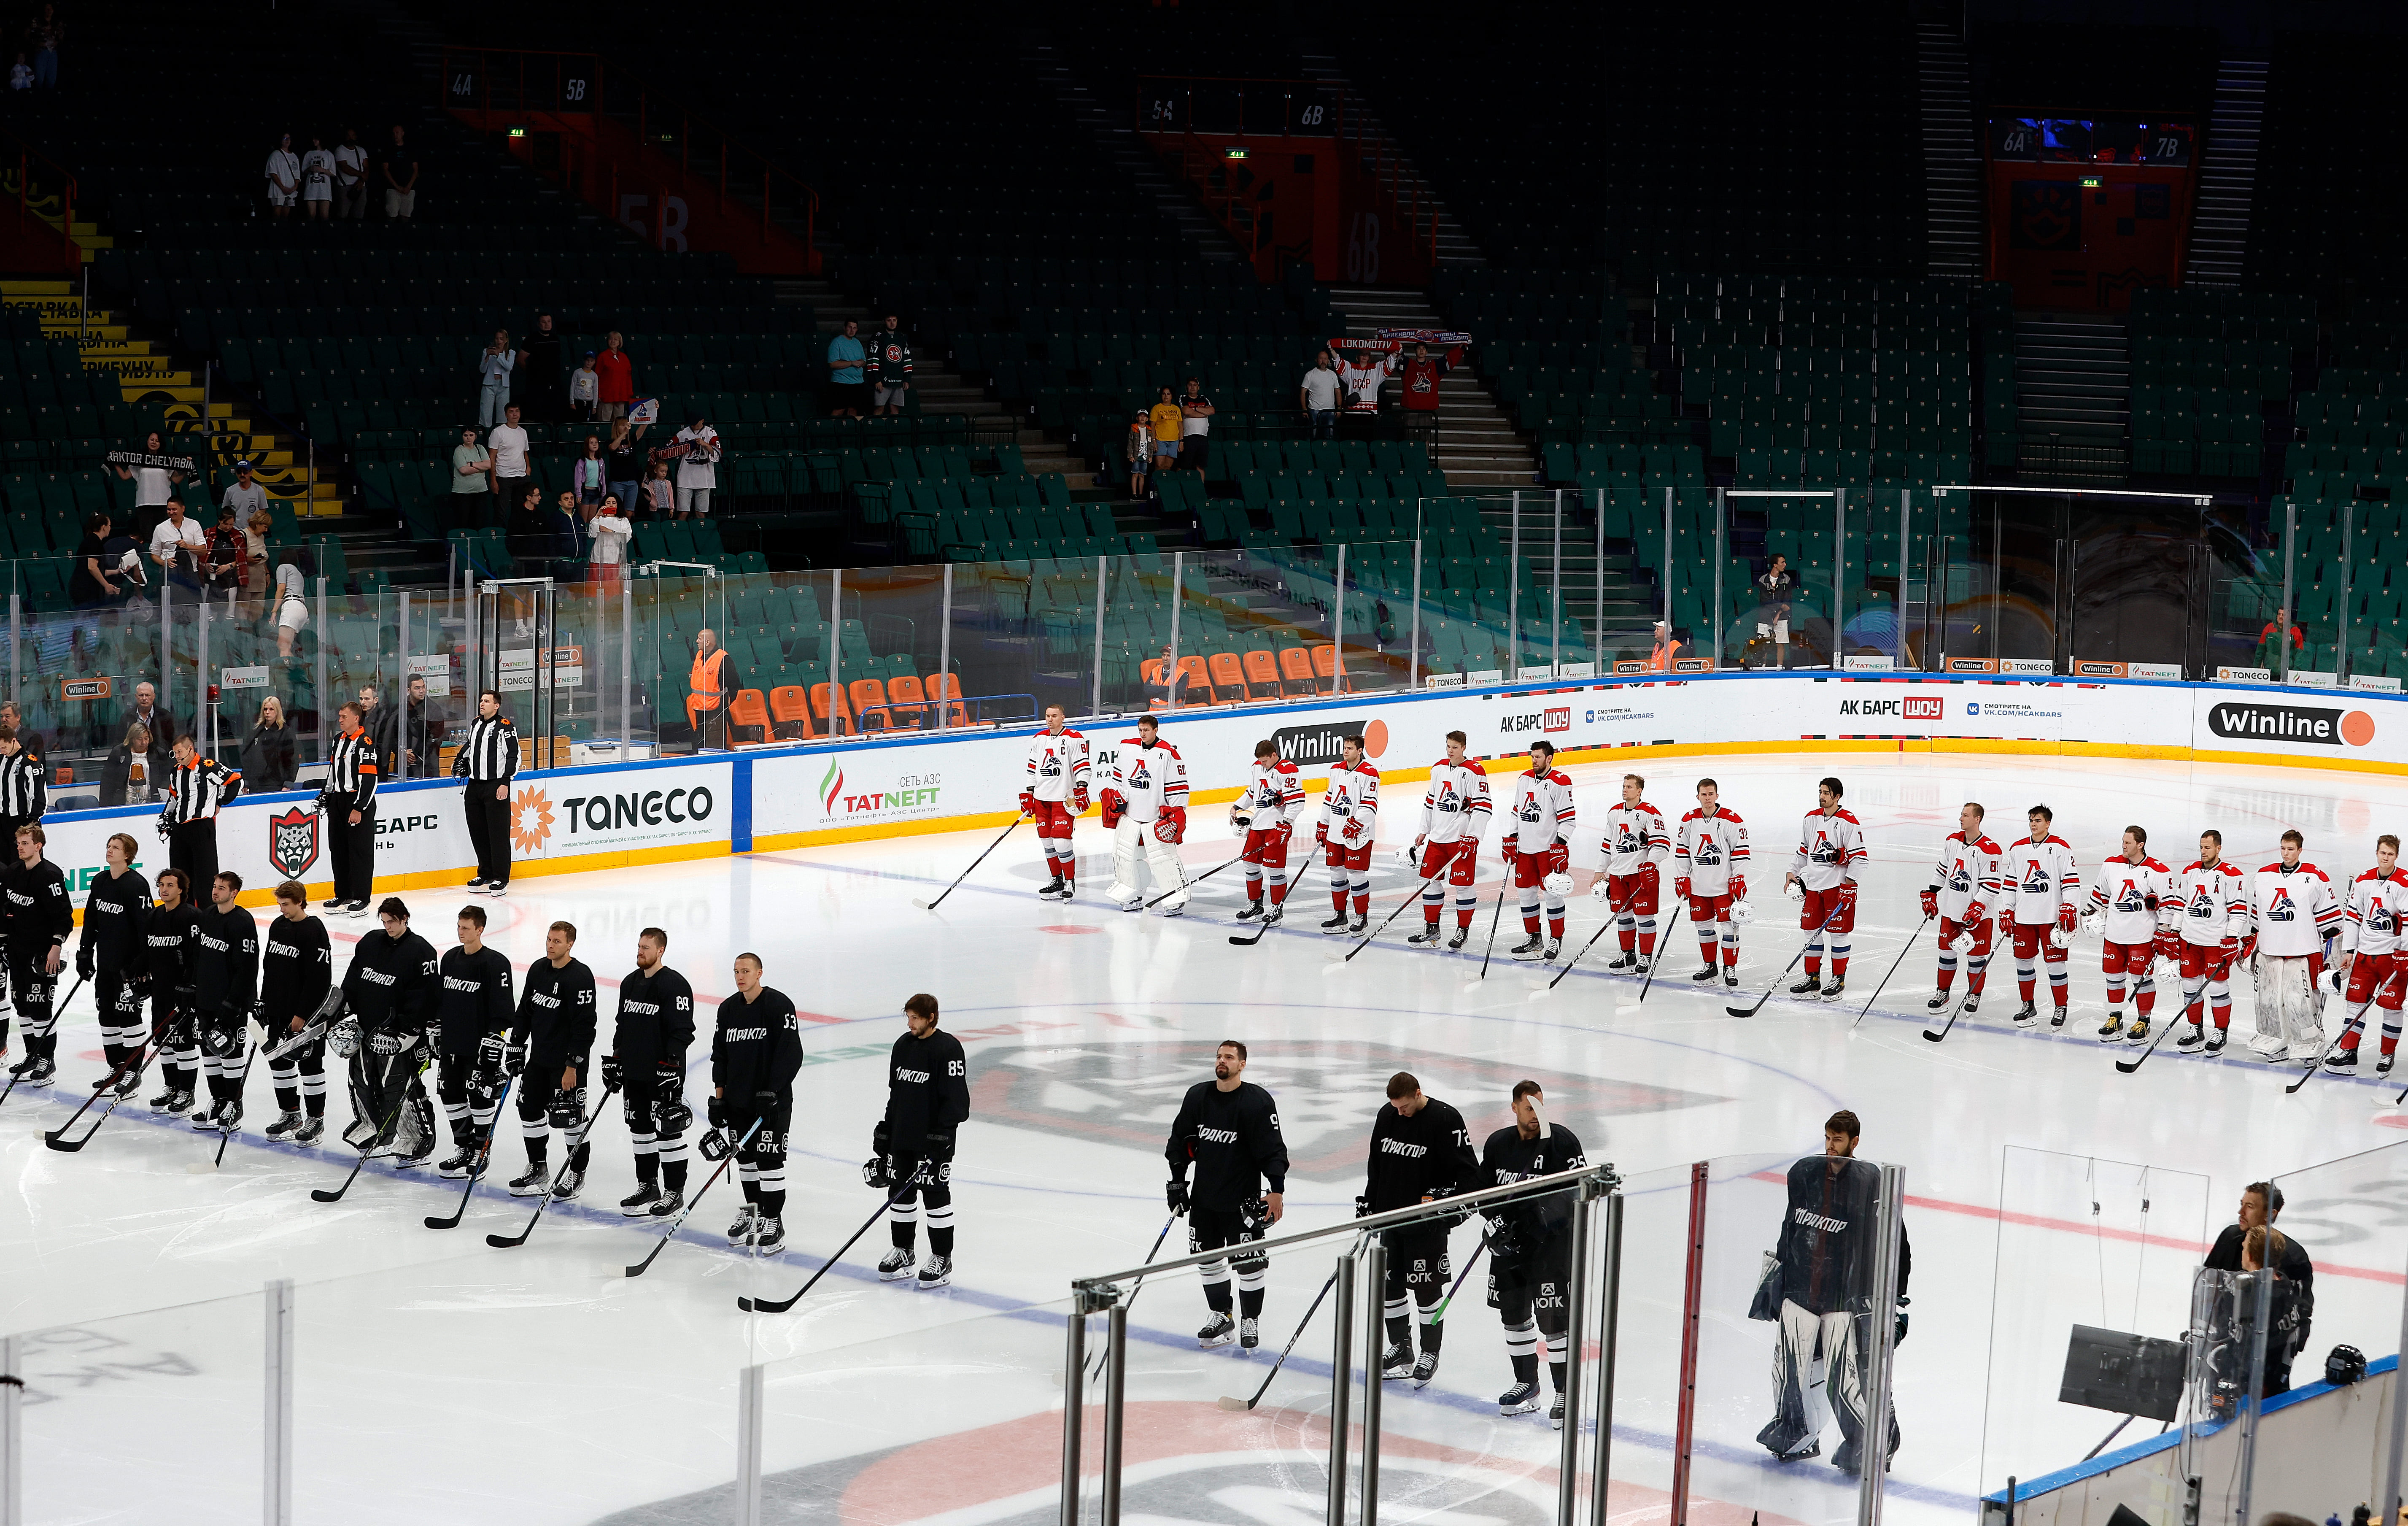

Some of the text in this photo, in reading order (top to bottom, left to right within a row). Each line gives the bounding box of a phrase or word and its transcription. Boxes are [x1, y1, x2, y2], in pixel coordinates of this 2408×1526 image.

[453, 74, 471, 96] 4A
[567, 79, 585, 100] 5B
[1152, 100, 1174, 120] 5A
[1302, 105, 1323, 125] 6B
[2004, 132, 2024, 152] 6A
[2156, 138, 2178, 157] 7B
[1348, 212, 1380, 284] 6B
[870, 345, 878, 354] 47
[1341, 339, 1392, 349] LOKOMOTIV
[904, 347, 910, 355] 4
[1353, 378, 1371, 389] СССР
[108, 451, 143, 464] RAKTOR
[1955, 661, 1981, 669] Winline
[2084, 664, 2111, 673] Winline
[232, 676, 266, 684] TATNEFT
[68, 683, 95, 694] Winline
[2361, 683, 2396, 691] TATNEFT
[1839, 700, 1941, 717] АК БАРС ШОУ
[1984, 709, 2062, 718] VK.COM/HCAKBARS
[1500, 708, 1569, 733] АК БАРС ШОУ
[1597, 712, 1654, 722] VK.COM/HCAKBARS
[2220, 708, 2330, 738] Winline
[1060, 747, 1065, 755] C
[1278, 730, 1344, 759] Winlin
[1177, 764, 1186, 775] 60
[900, 773, 941, 787] СЕТЬ АЗС
[1284, 778, 1296, 788] 92
[844, 787, 940, 813] TATNEFT
[375, 815, 438, 834] БАРС
[1654, 819, 1665, 831] 99
[49, 882, 62, 897] 16
[2214, 884, 2219, 894] A
[242, 938, 255, 954] 96
[501, 972, 509, 987] 2
[26, 994, 45, 1002] ЮГК
[577, 990, 592, 1005] 55
[676, 995, 689, 1012] 89
[115, 1002, 134, 1012] ЮГК
[783, 1013, 798, 1030] 53
[948, 1060, 964, 1076] 85
[757, 1142, 779, 1154] ЮГК
[1534, 1154, 1543, 1169] A
[1407, 1272, 1432, 1283] ЮГК
[1536, 1296, 1564, 1308] ЮГК
